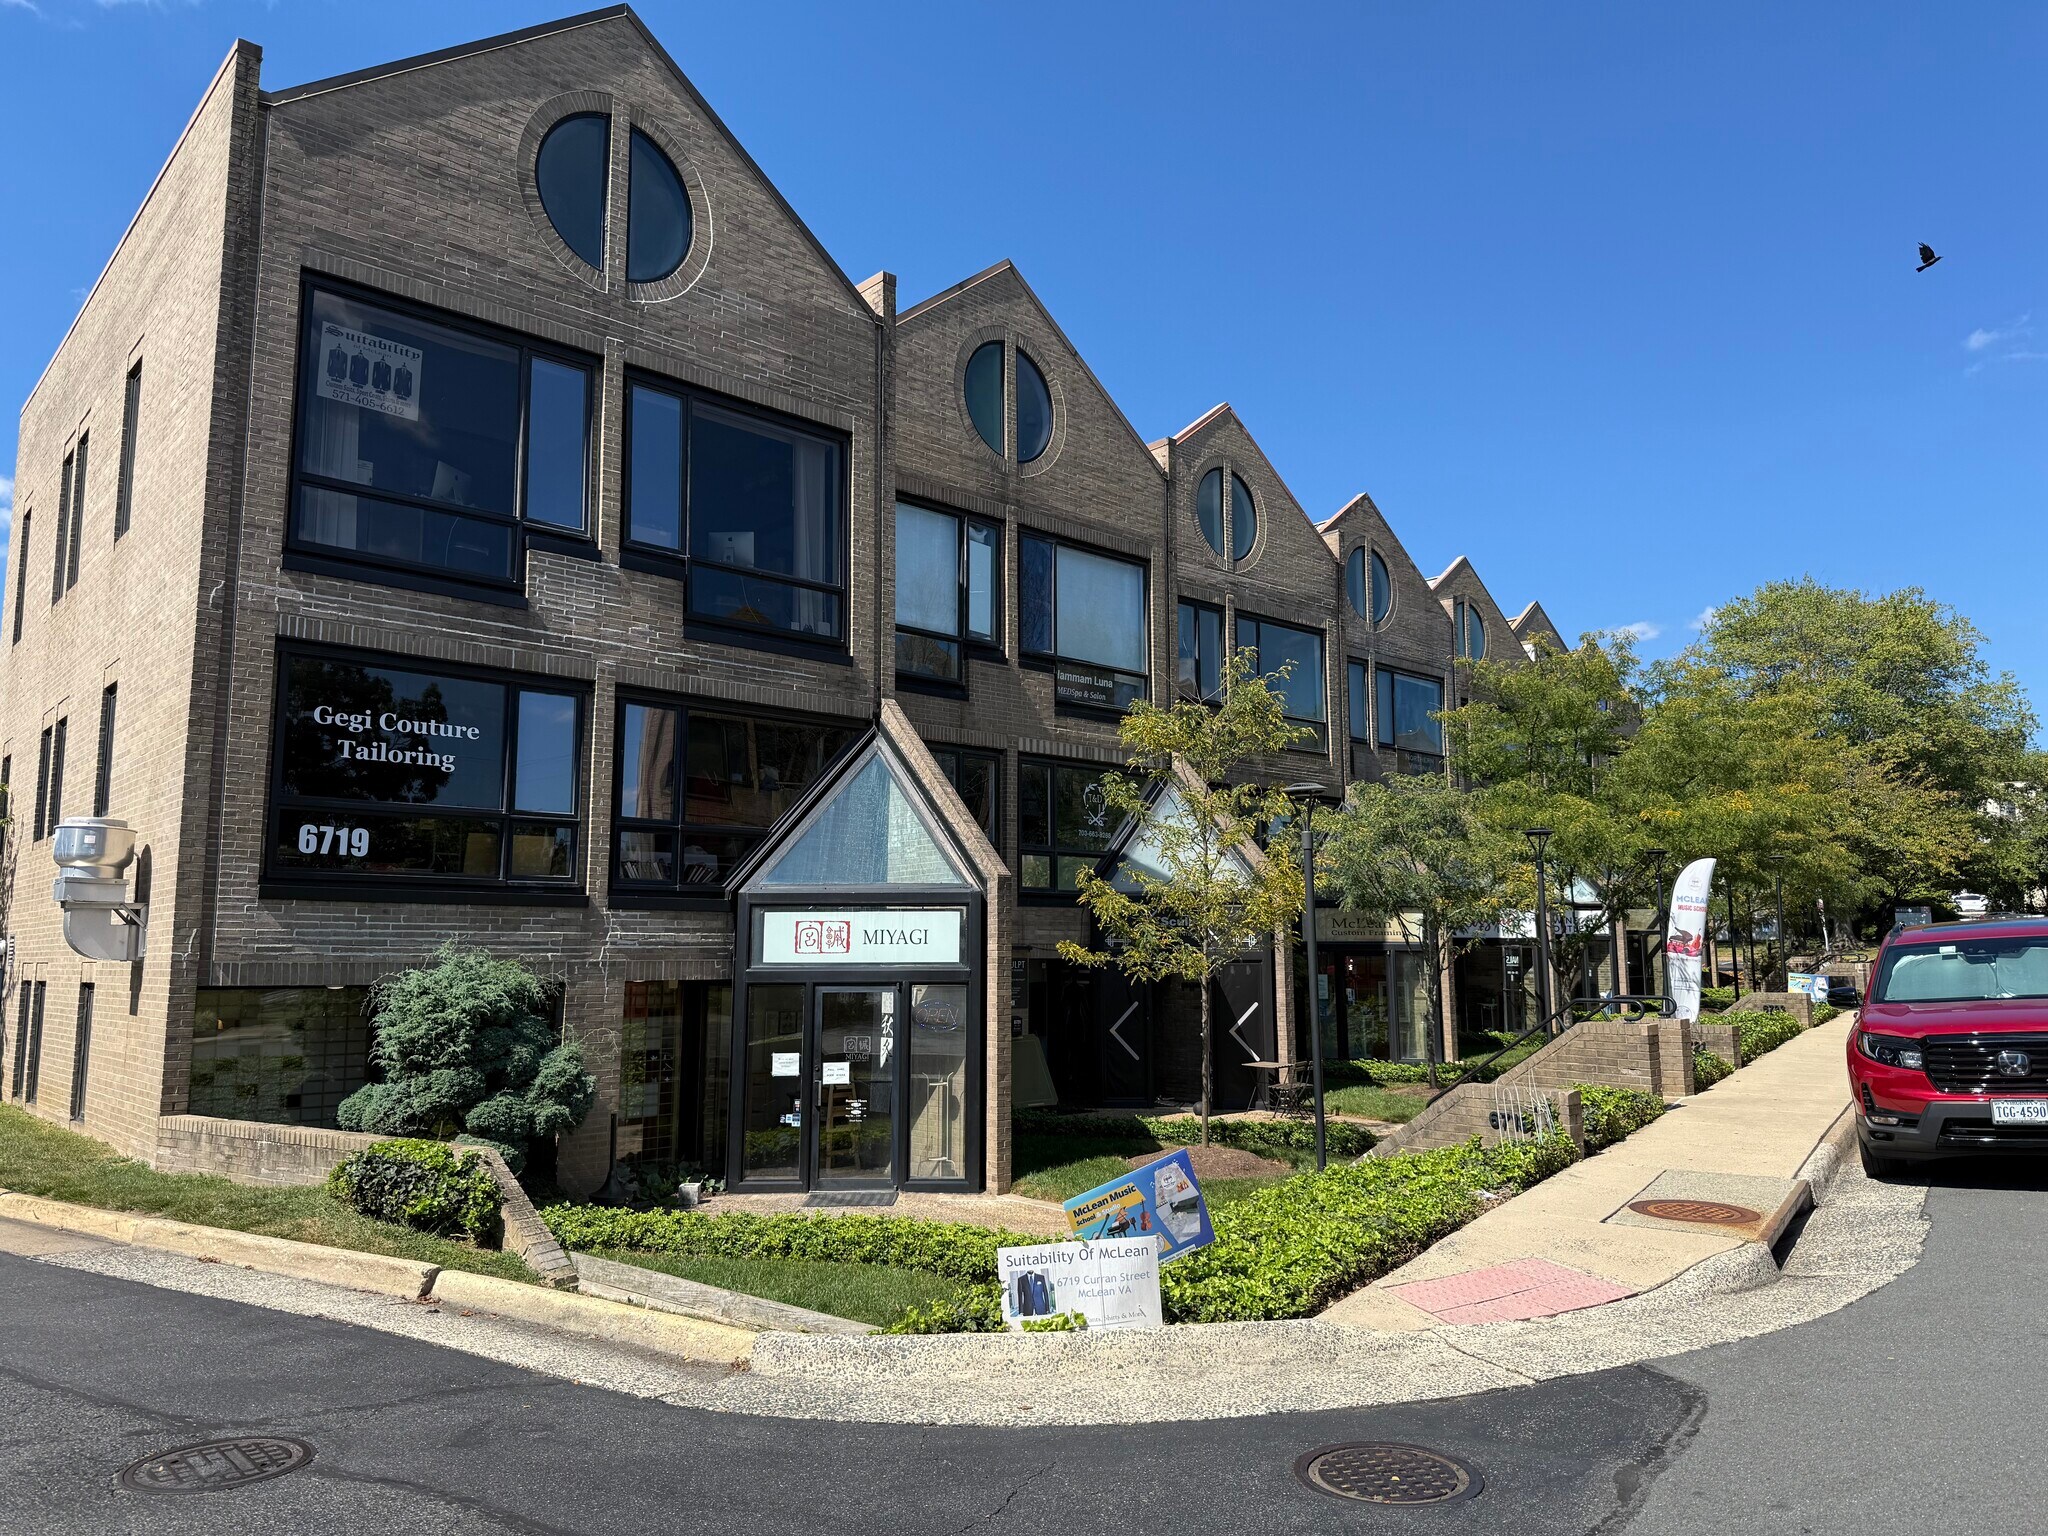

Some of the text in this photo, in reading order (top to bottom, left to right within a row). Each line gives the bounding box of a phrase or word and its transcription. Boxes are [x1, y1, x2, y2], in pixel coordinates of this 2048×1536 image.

[324, 325, 421, 362] Suitability
[332, 389, 405, 416] 571-405-6612
[1094, 676, 1113, 688] Luna
[1083, 690, 1089, 698] &
[1090, 691, 1106, 701] Salon
[313, 705, 480, 740] Gegi Couture
[337, 739, 456, 773] Tailoring
[298, 824, 370, 857] 6719
[862, 928, 929, 945] MIYAGI
[914, 1007, 959, 1025] OPEN
[1995, 1106, 2047, 1118] TGG-4590
[1072, 1185, 1137, 1219] McLean Music
[1075, 1213, 1097, 1227] School
[1101, 1203, 1121, 1215] Studio
[1006, 1252, 1075, 1268] Suitability
[1079, 1247, 1095, 1261] Of
[1099, 1246, 1149, 1259] McLean
[1057, 1270, 1150, 1287] 6719 Curran Street
[1077, 1285, 1132, 1298] McLean VA
